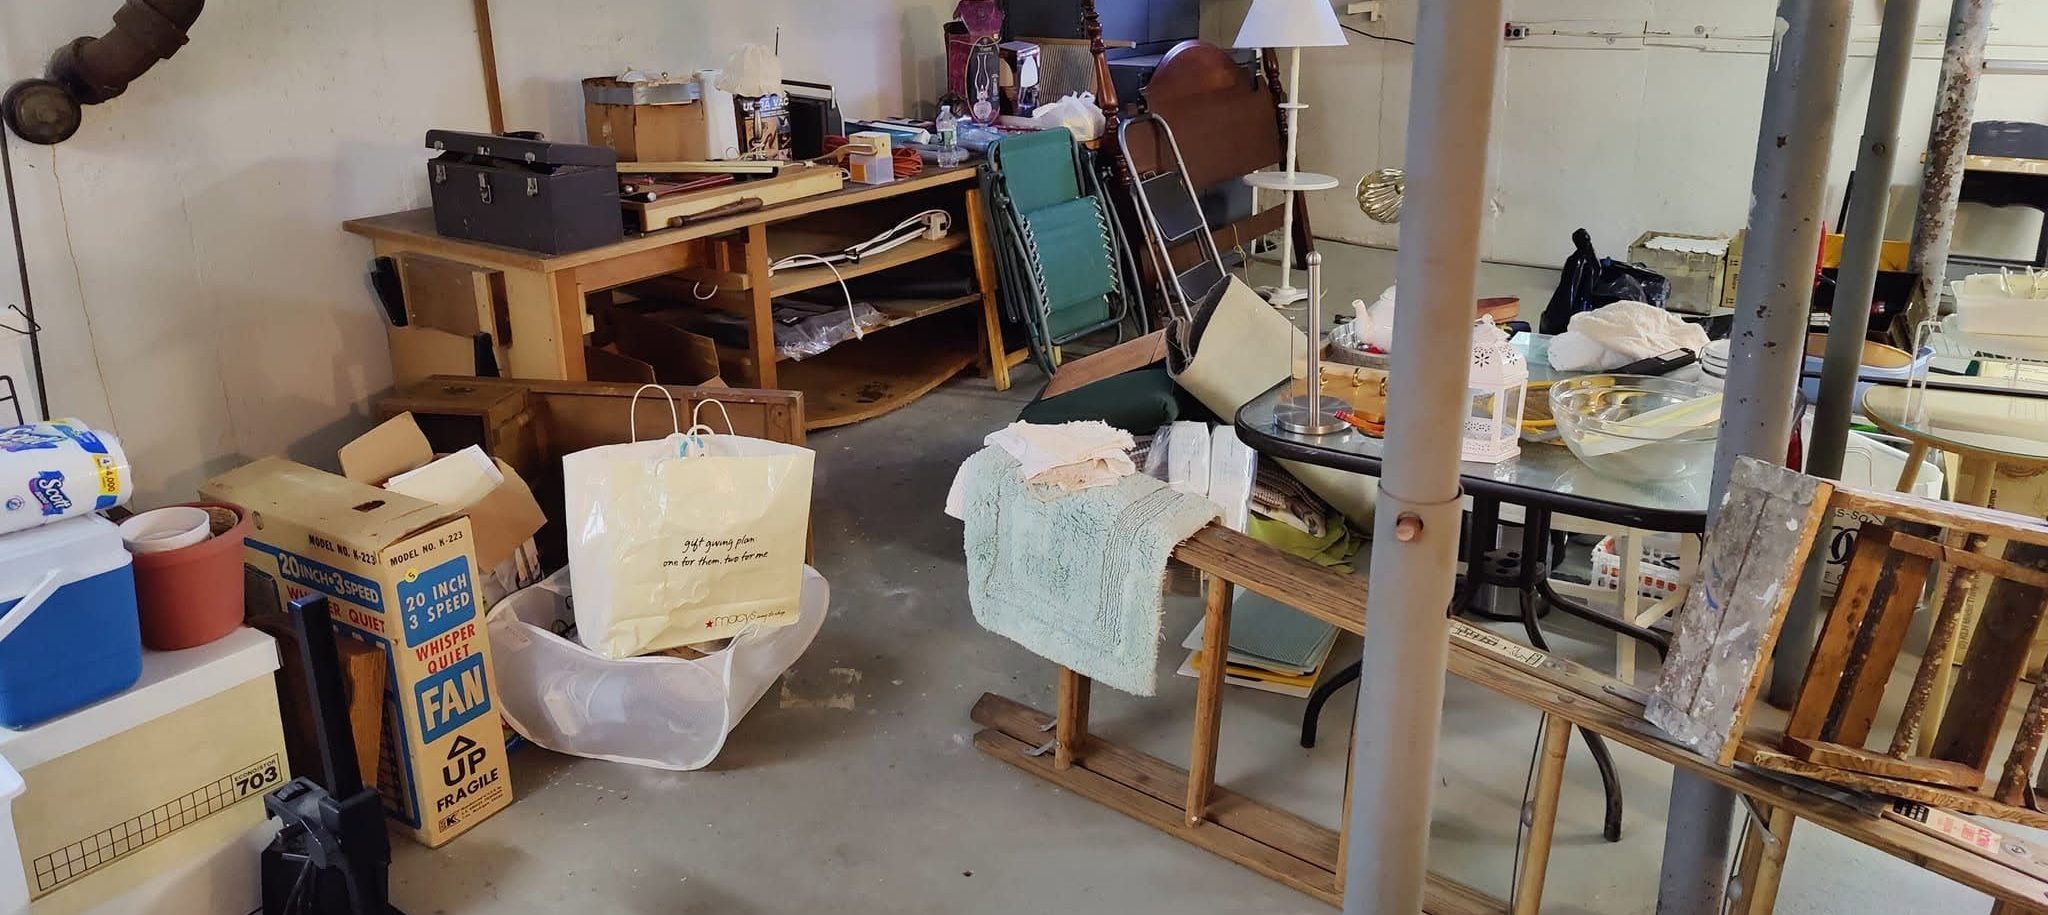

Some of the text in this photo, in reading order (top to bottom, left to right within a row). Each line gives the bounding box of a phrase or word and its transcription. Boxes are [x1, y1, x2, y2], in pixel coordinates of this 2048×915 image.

[743, 97, 789, 111] ULRA VAC
[39, 479, 72, 509] Scott
[105, 471, 116, 493] 4,000
[308, 534, 377, 566] MODEL NO. K-223
[390, 531, 463, 567] MODEL NO. K-223
[682, 537, 704, 553] gift
[705, 539, 733, 553] giving
[682, 556, 695, 567] for
[724, 555, 739, 564] two
[741, 551, 754, 561] for
[405, 573, 467, 612] 20 INCH
[348, 608, 385, 633] QUIET
[409, 591, 470, 630] 3 SPEED
[415, 623, 476, 662] WHISPER
[427, 643, 469, 674] QUIET
[421, 665, 485, 732] FAN
[236, 766, 278, 796] 703
[443, 747, 486, 787] UP
[437, 768, 498, 813] FRAGILE
